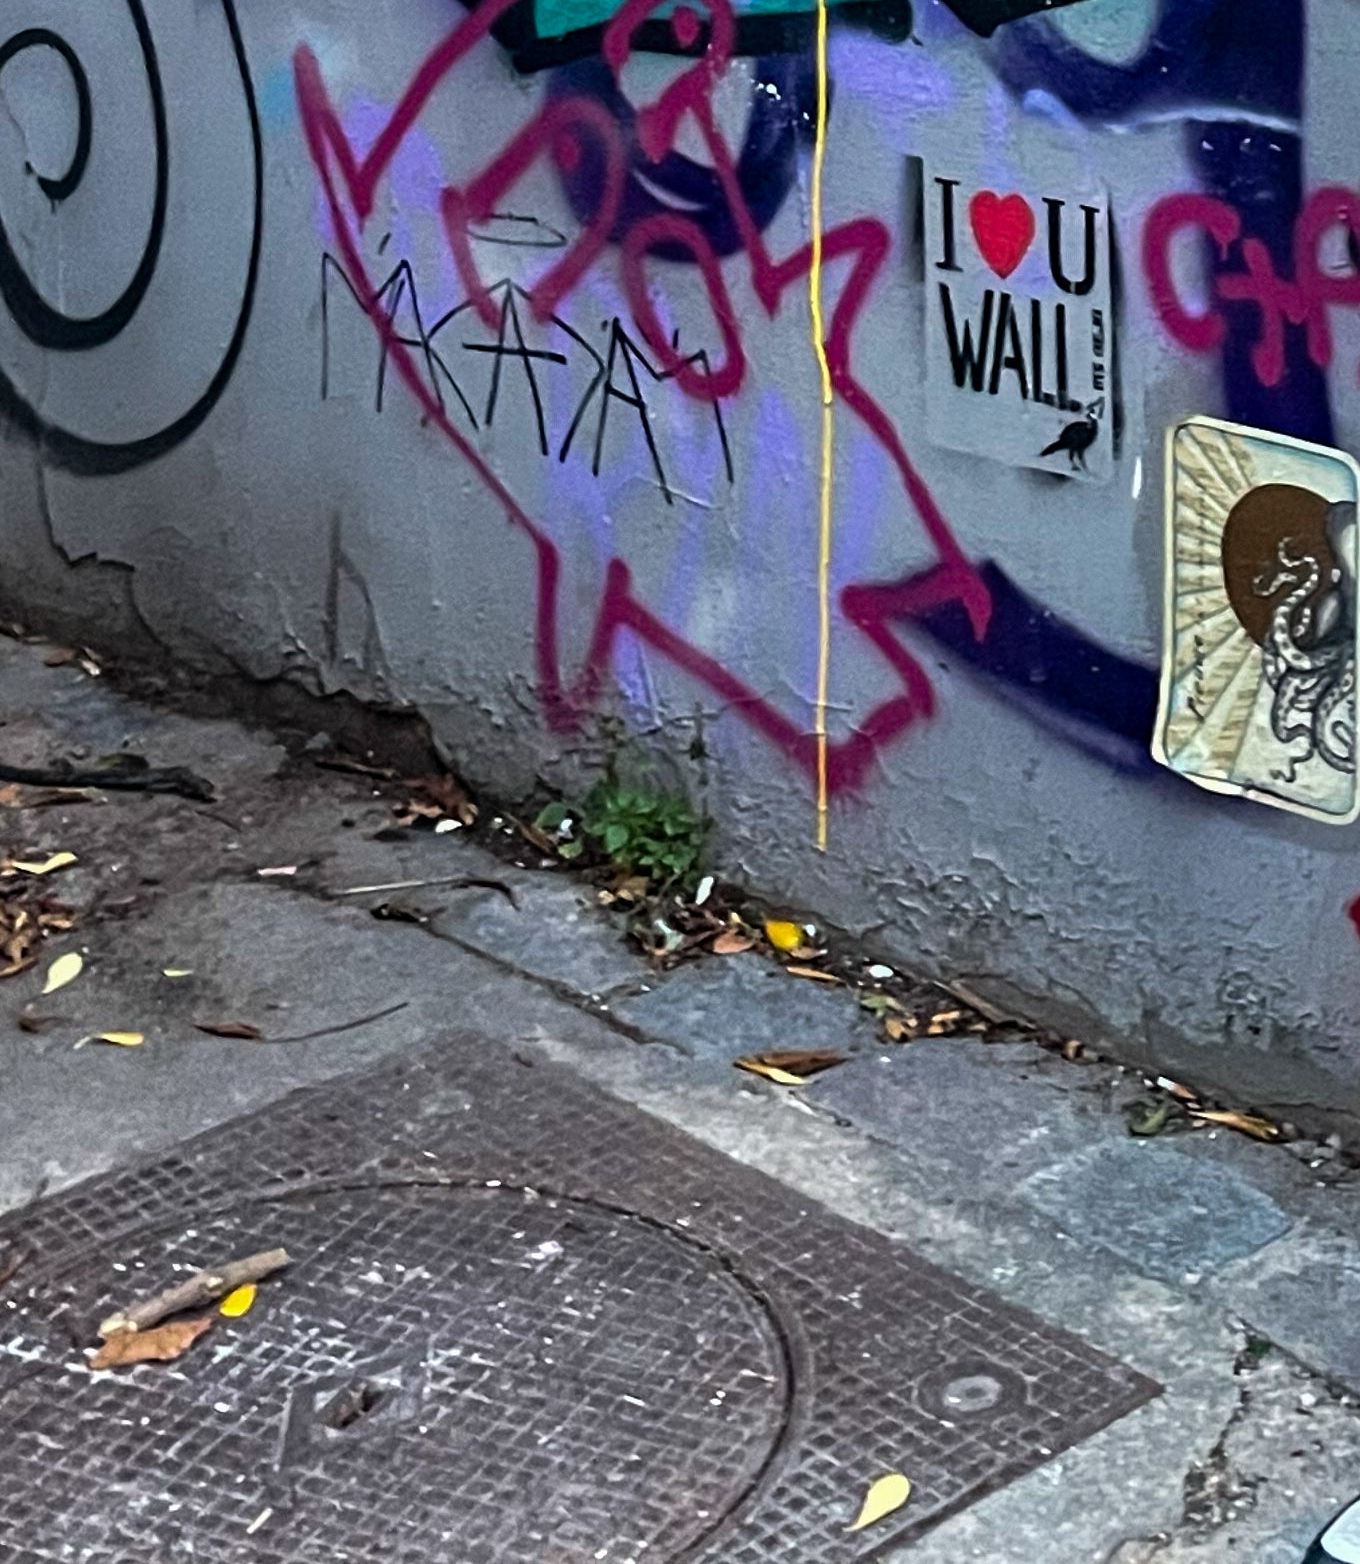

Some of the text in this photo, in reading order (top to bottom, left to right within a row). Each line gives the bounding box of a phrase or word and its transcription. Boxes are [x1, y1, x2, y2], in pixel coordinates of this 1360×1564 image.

[934, 176, 1100, 296] I U
[938, 281, 1084, 412] WALL
